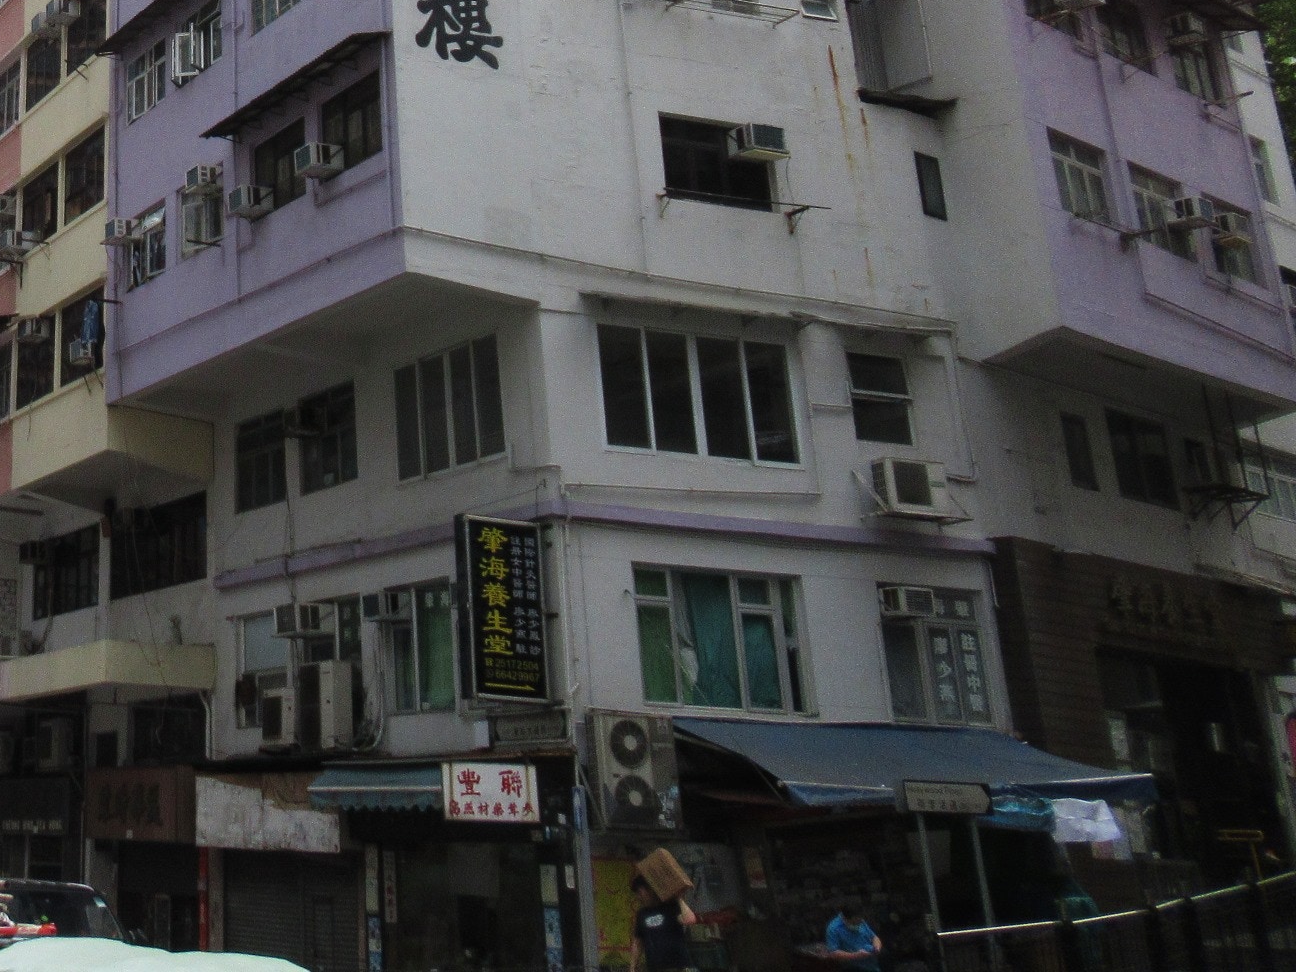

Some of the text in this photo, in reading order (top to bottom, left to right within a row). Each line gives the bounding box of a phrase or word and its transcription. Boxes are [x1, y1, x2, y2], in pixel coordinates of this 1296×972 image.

[478, 527, 513, 656] 肇海養生堂
